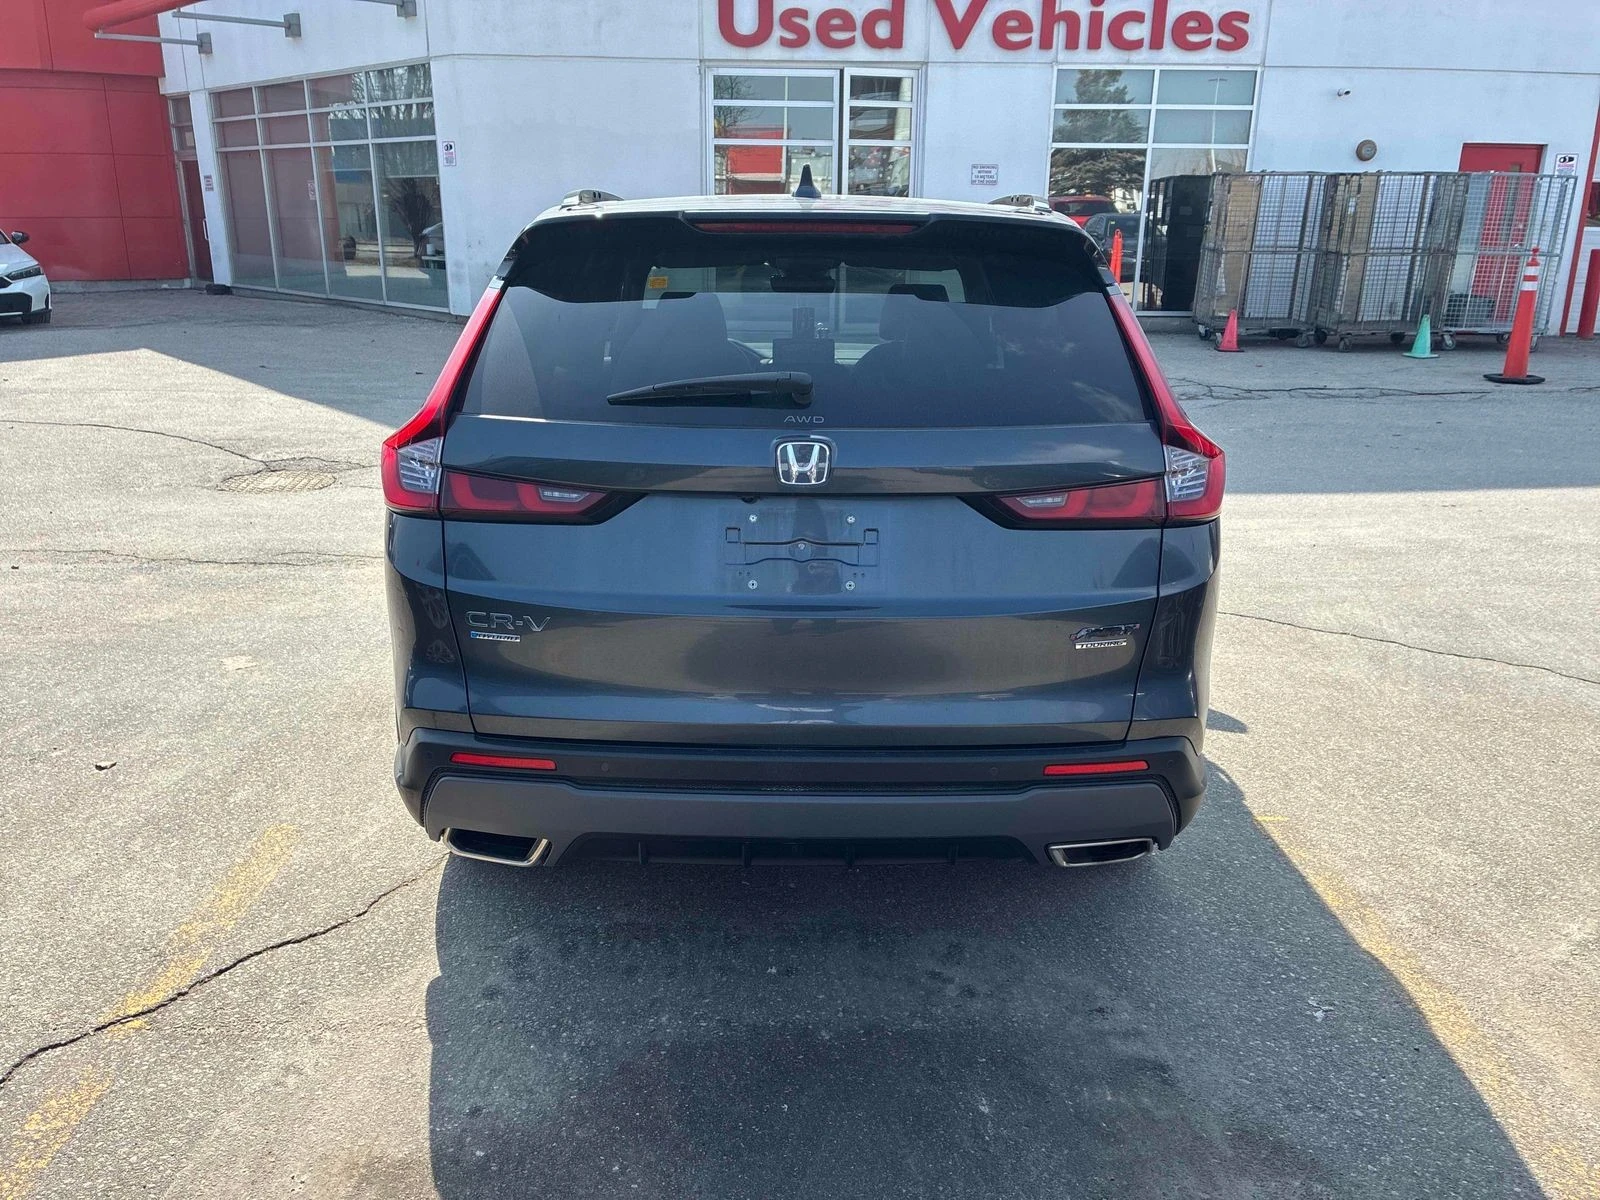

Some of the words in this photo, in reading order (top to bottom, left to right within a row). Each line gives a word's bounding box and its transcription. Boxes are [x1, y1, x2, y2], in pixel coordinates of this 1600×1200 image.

[718, 0, 905, 49] Used
[935, 0, 1250, 50] Vehicles
[783, 415, 825, 424] AWD
[465, 610, 551, 632] CR-V
[1080, 640, 1126, 649] TOURING
